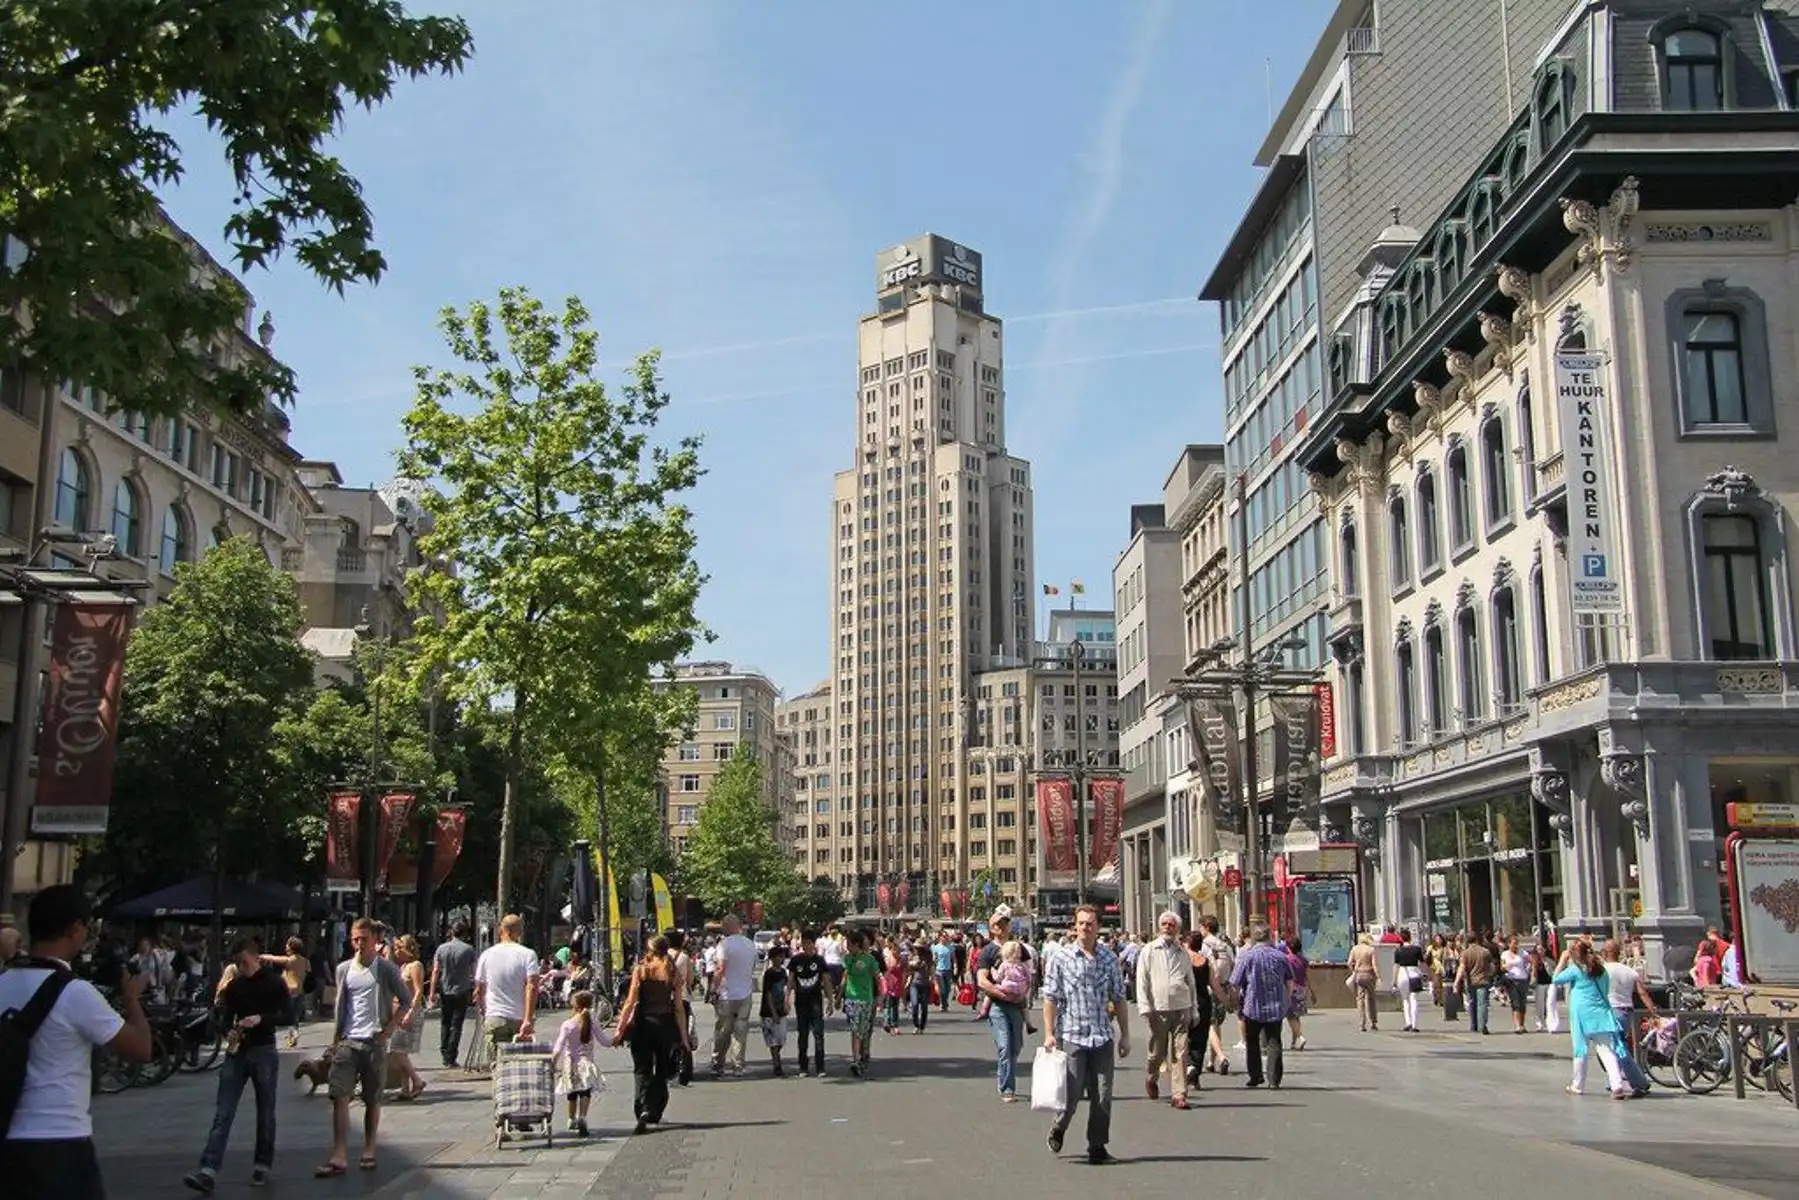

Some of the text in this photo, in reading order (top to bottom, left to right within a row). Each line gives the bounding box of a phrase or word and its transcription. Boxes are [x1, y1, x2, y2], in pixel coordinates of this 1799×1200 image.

[882, 262, 920, 285] KBC
[943, 262, 977, 286] KBC
[1571, 372, 1591, 384] TE
[1560, 386, 1604, 398] HUUR
[1578, 401, 1600, 538] KANTOREN
[1587, 556, 1601, 575] P
[1319, 685, 1334, 739] Kruidvat
